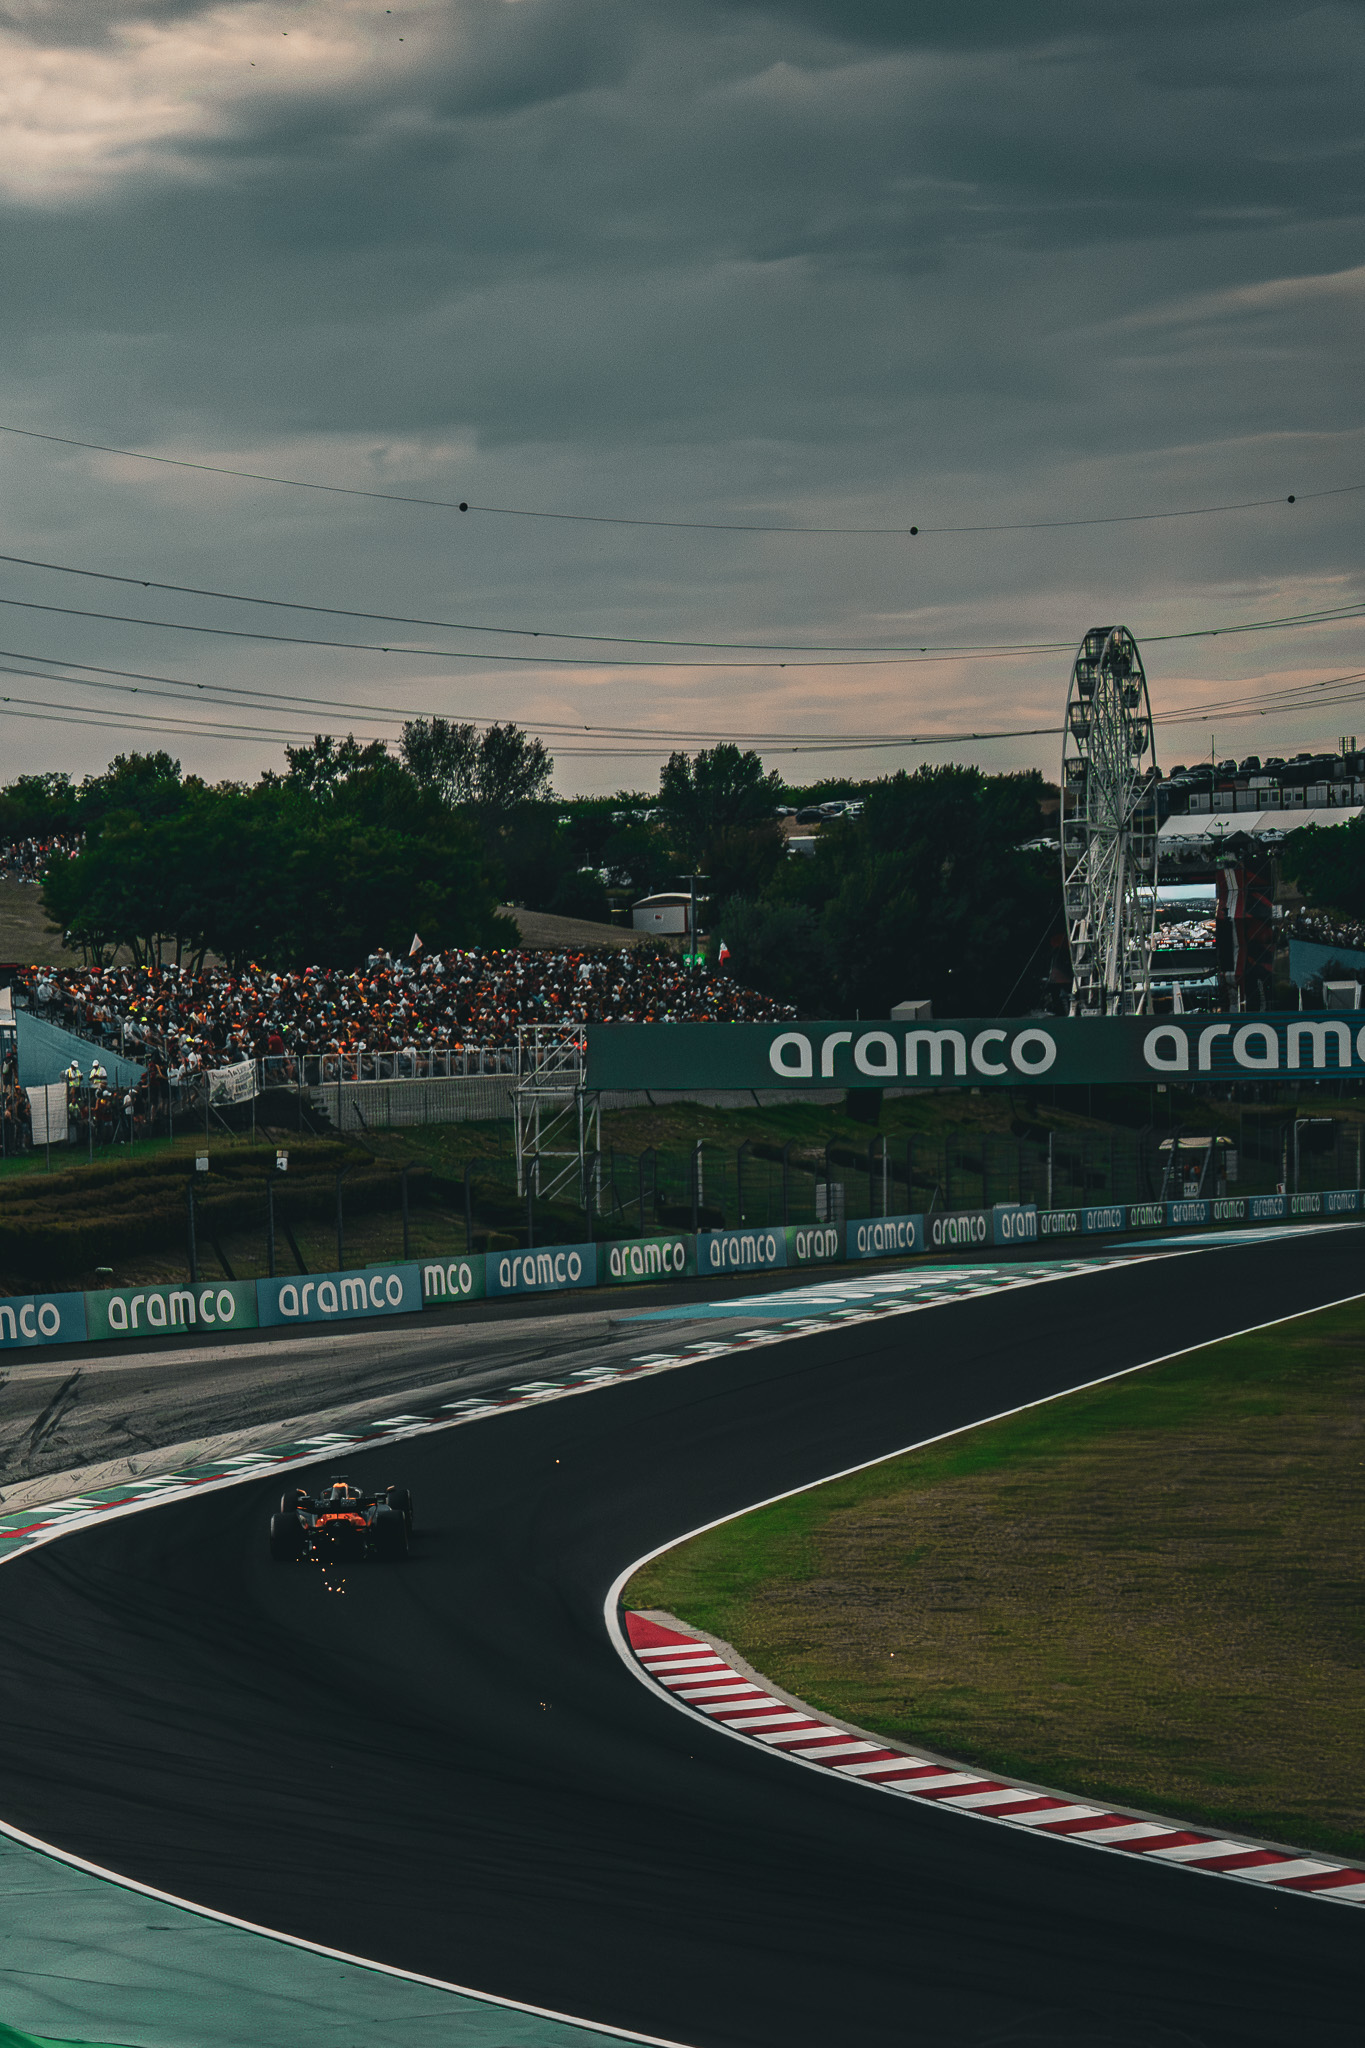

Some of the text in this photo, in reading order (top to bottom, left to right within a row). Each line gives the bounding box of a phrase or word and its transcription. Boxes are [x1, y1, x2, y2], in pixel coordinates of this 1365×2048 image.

[769, 1028, 1057, 1078] aramco
[1143, 1020, 1365, 1072] aram
[1131, 1206, 1162, 1226] aramco
[1173, 1203, 1205, 1222] aramco
[1214, 1200, 1245, 1219] aramco
[1254, 1198, 1284, 1216] aramco
[1292, 1195, 1320, 1213] aramco
[1329, 1194, 1356, 1211] aramco
[932, 1214, 986, 1245] aramco
[1002, 1210, 1036, 1238] aram
[1041, 1213, 1077, 1234] aramco
[1087, 1209, 1122, 1230] aramco
[710, 1234, 776, 1267] aramco
[858, 1221, 915, 1252] aramco
[500, 1252, 582, 1287] aramco
[610, 1242, 685, 1276] aramco
[424, 1262, 472, 1296] mco
[108, 1289, 236, 1330] aramco
[278, 1274, 404, 1316] aramco
